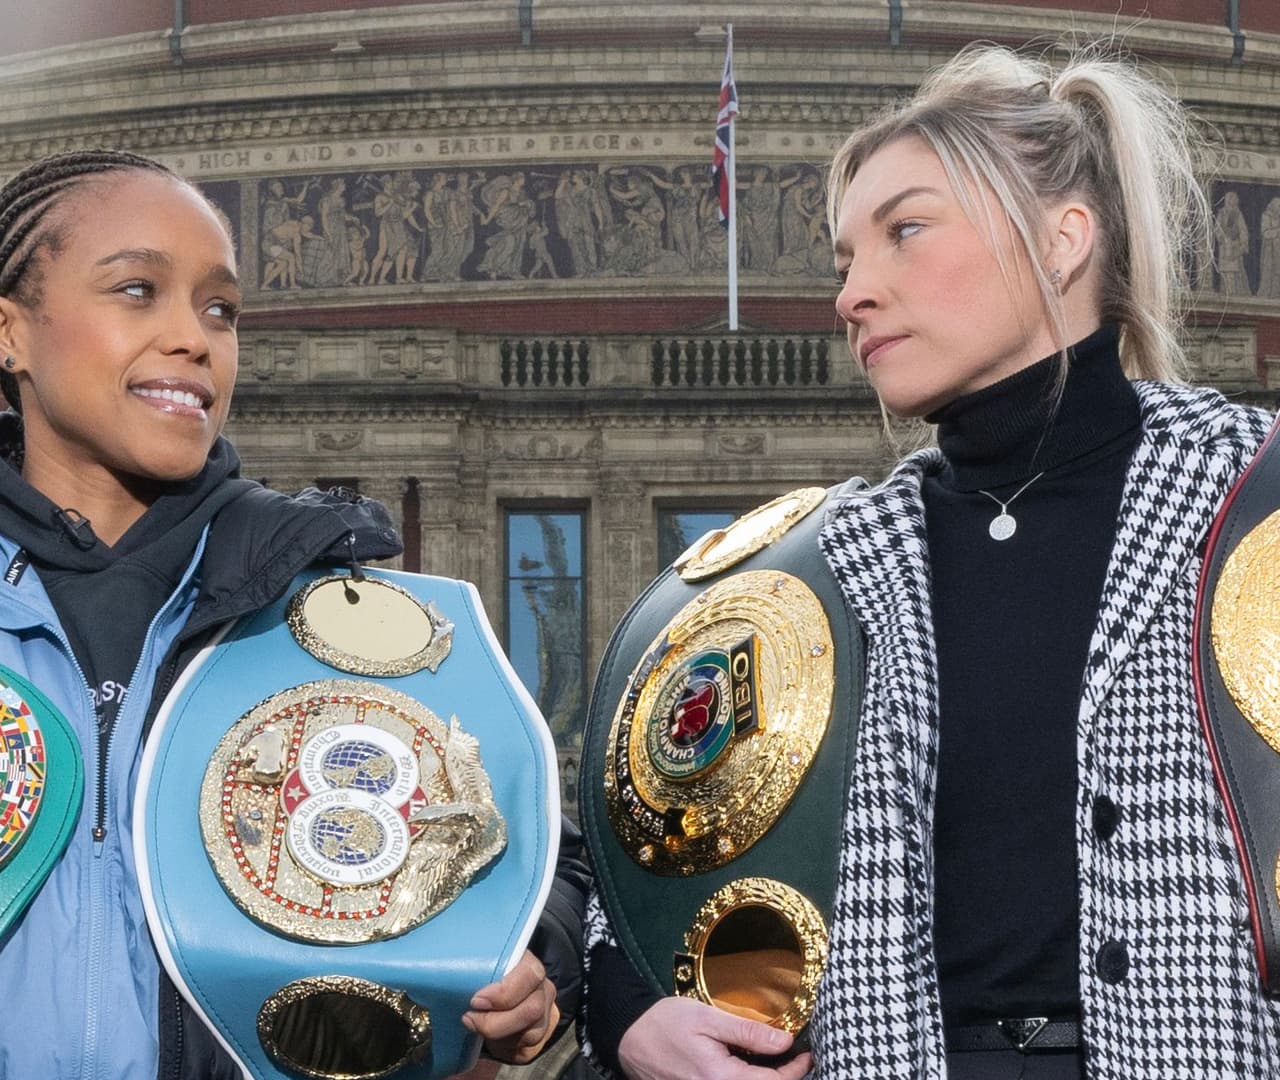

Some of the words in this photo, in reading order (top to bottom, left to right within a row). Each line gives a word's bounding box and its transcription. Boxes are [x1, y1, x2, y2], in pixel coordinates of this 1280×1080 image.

[287, 145, 333, 163] AND
[370, 142, 401, 158] ON
[437, 137, 512, 155] EARTH
[548, 134, 621, 152] PEACE
[714, 669, 732, 726] BOXING
[733, 651, 753, 723] IBO
[303, 729, 342, 793] Champion
[299, 790, 352, 821] Boxing
[291, 820, 341, 879] Federation
[358, 799, 405, 881] International
